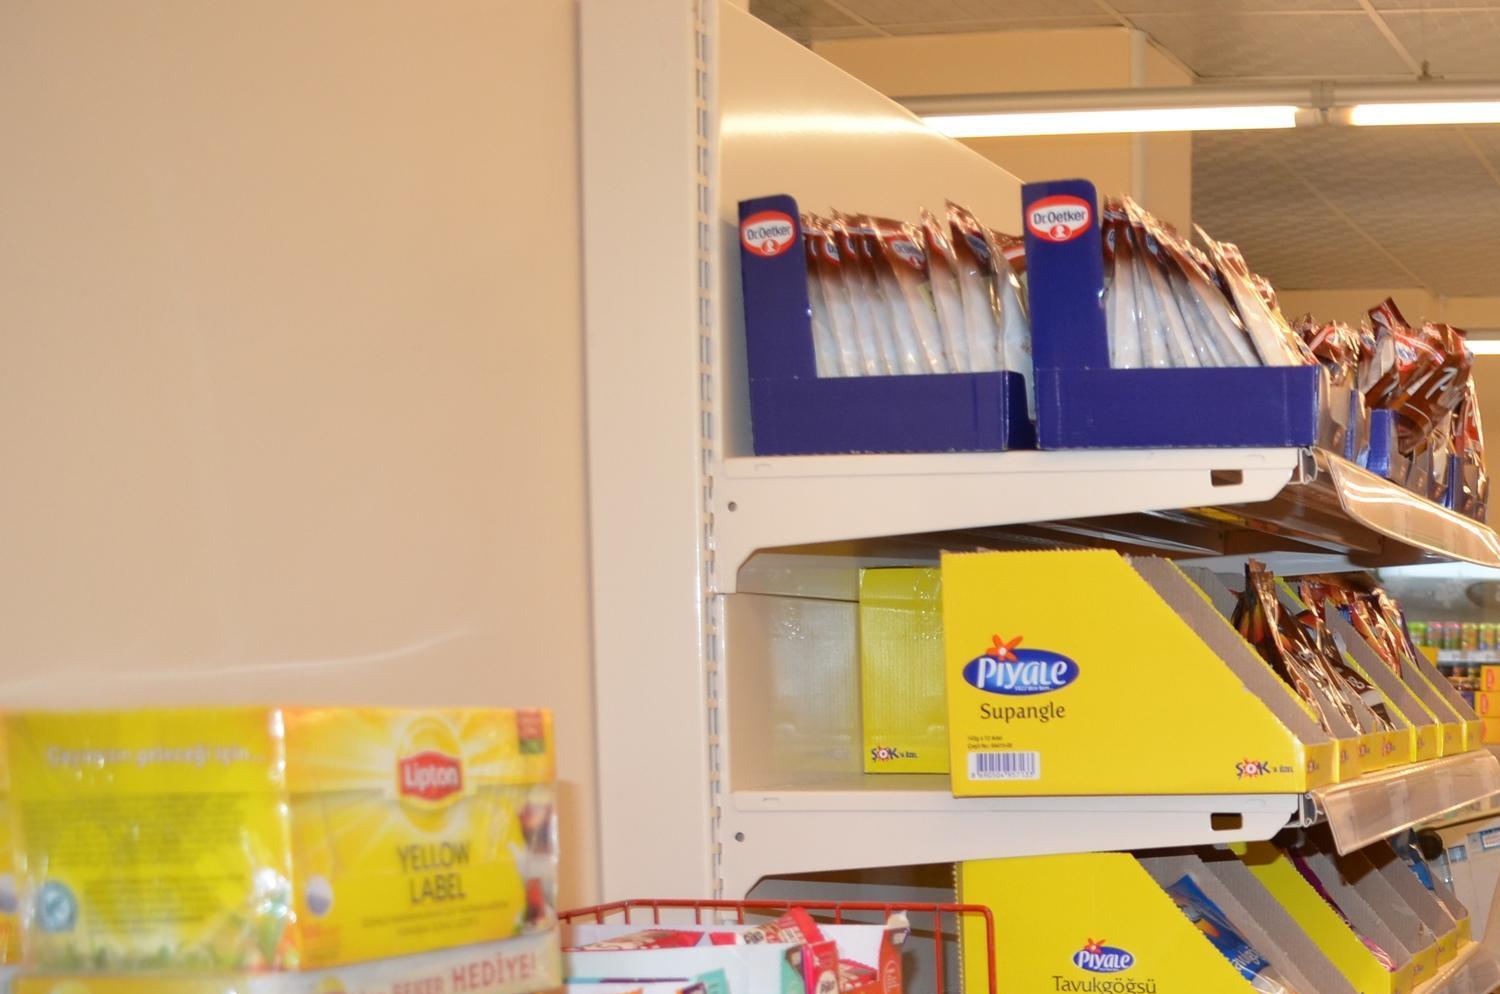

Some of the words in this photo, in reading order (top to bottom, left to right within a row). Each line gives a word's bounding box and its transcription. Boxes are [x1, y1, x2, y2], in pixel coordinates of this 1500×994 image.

[980, 701, 1066, 724] Supangle
[404, 763, 458, 791] Lipton
[397, 841, 470, 873] YELLOW
[409, 873, 467, 905] LABEL
